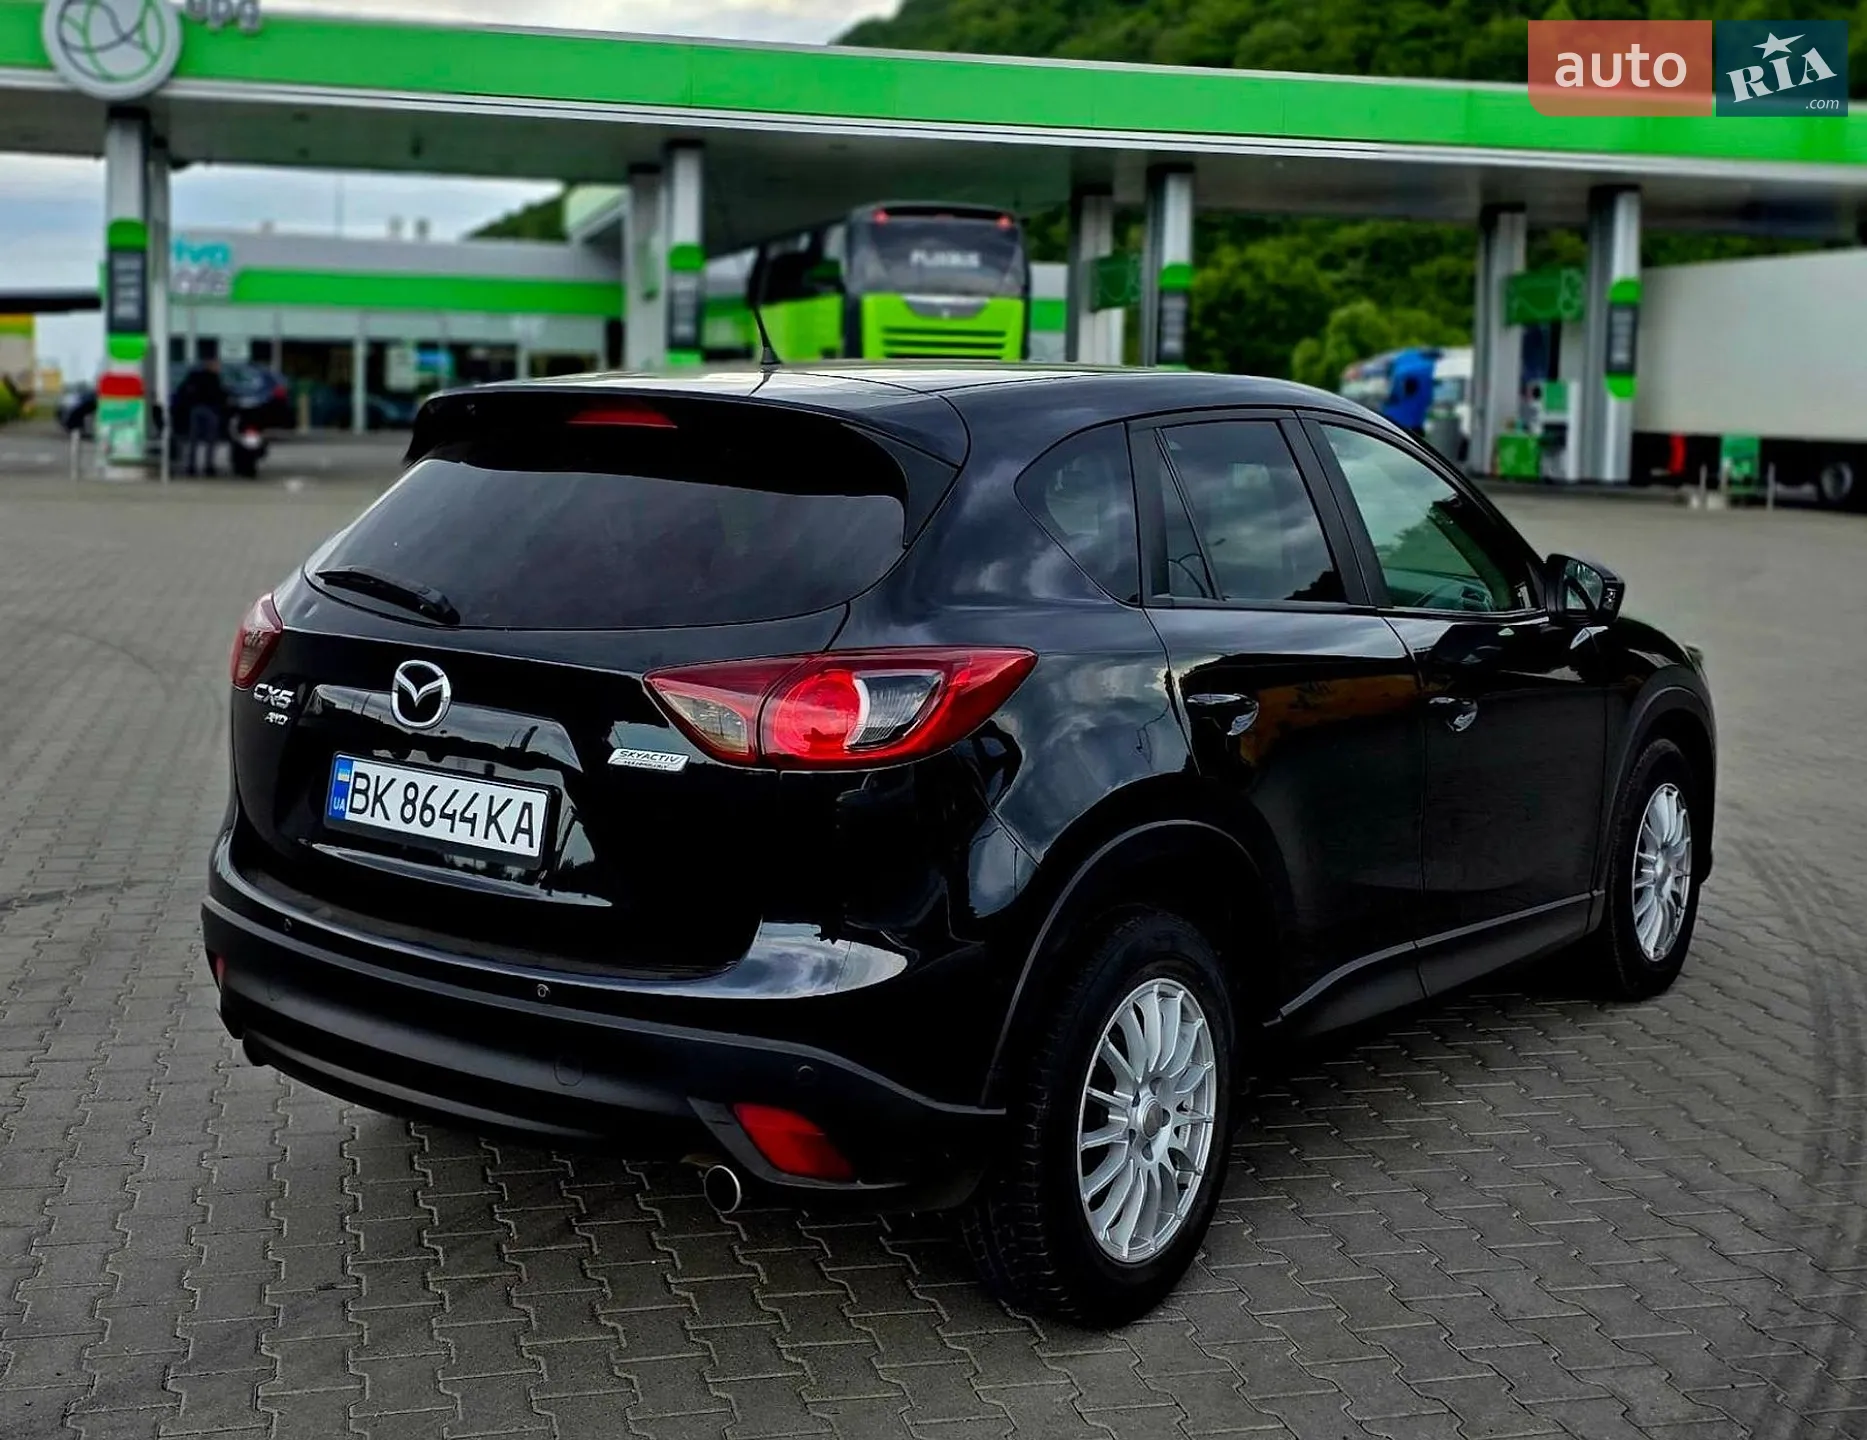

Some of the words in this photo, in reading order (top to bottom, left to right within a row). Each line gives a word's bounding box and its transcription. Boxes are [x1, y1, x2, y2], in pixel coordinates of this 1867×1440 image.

[620, 750, 679, 763] SKYACTIV
[333, 797, 346, 812] UA
[349, 771, 397, 822] BK
[400, 781, 480, 838] 8644
[483, 795, 534, 849] KA
